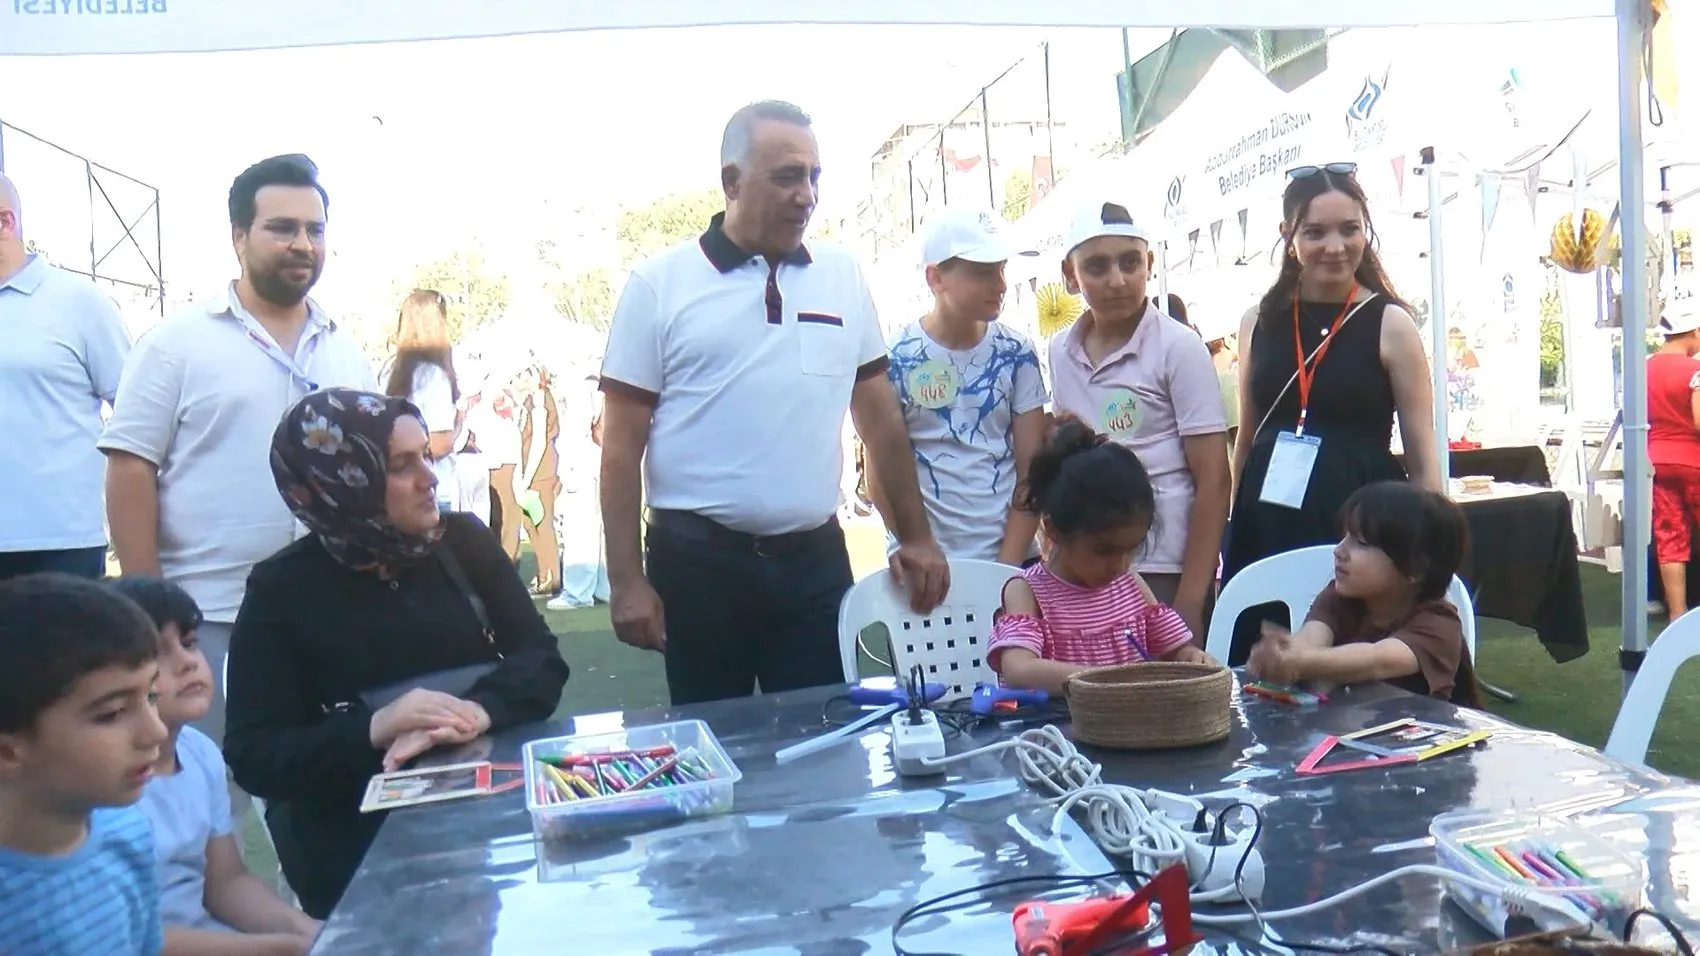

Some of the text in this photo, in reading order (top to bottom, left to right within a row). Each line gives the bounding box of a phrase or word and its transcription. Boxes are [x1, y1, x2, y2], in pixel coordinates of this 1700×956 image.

[1218, 145, 1301, 196] Belediye Başkanı
[1108, 412, 1133, 432] 443
